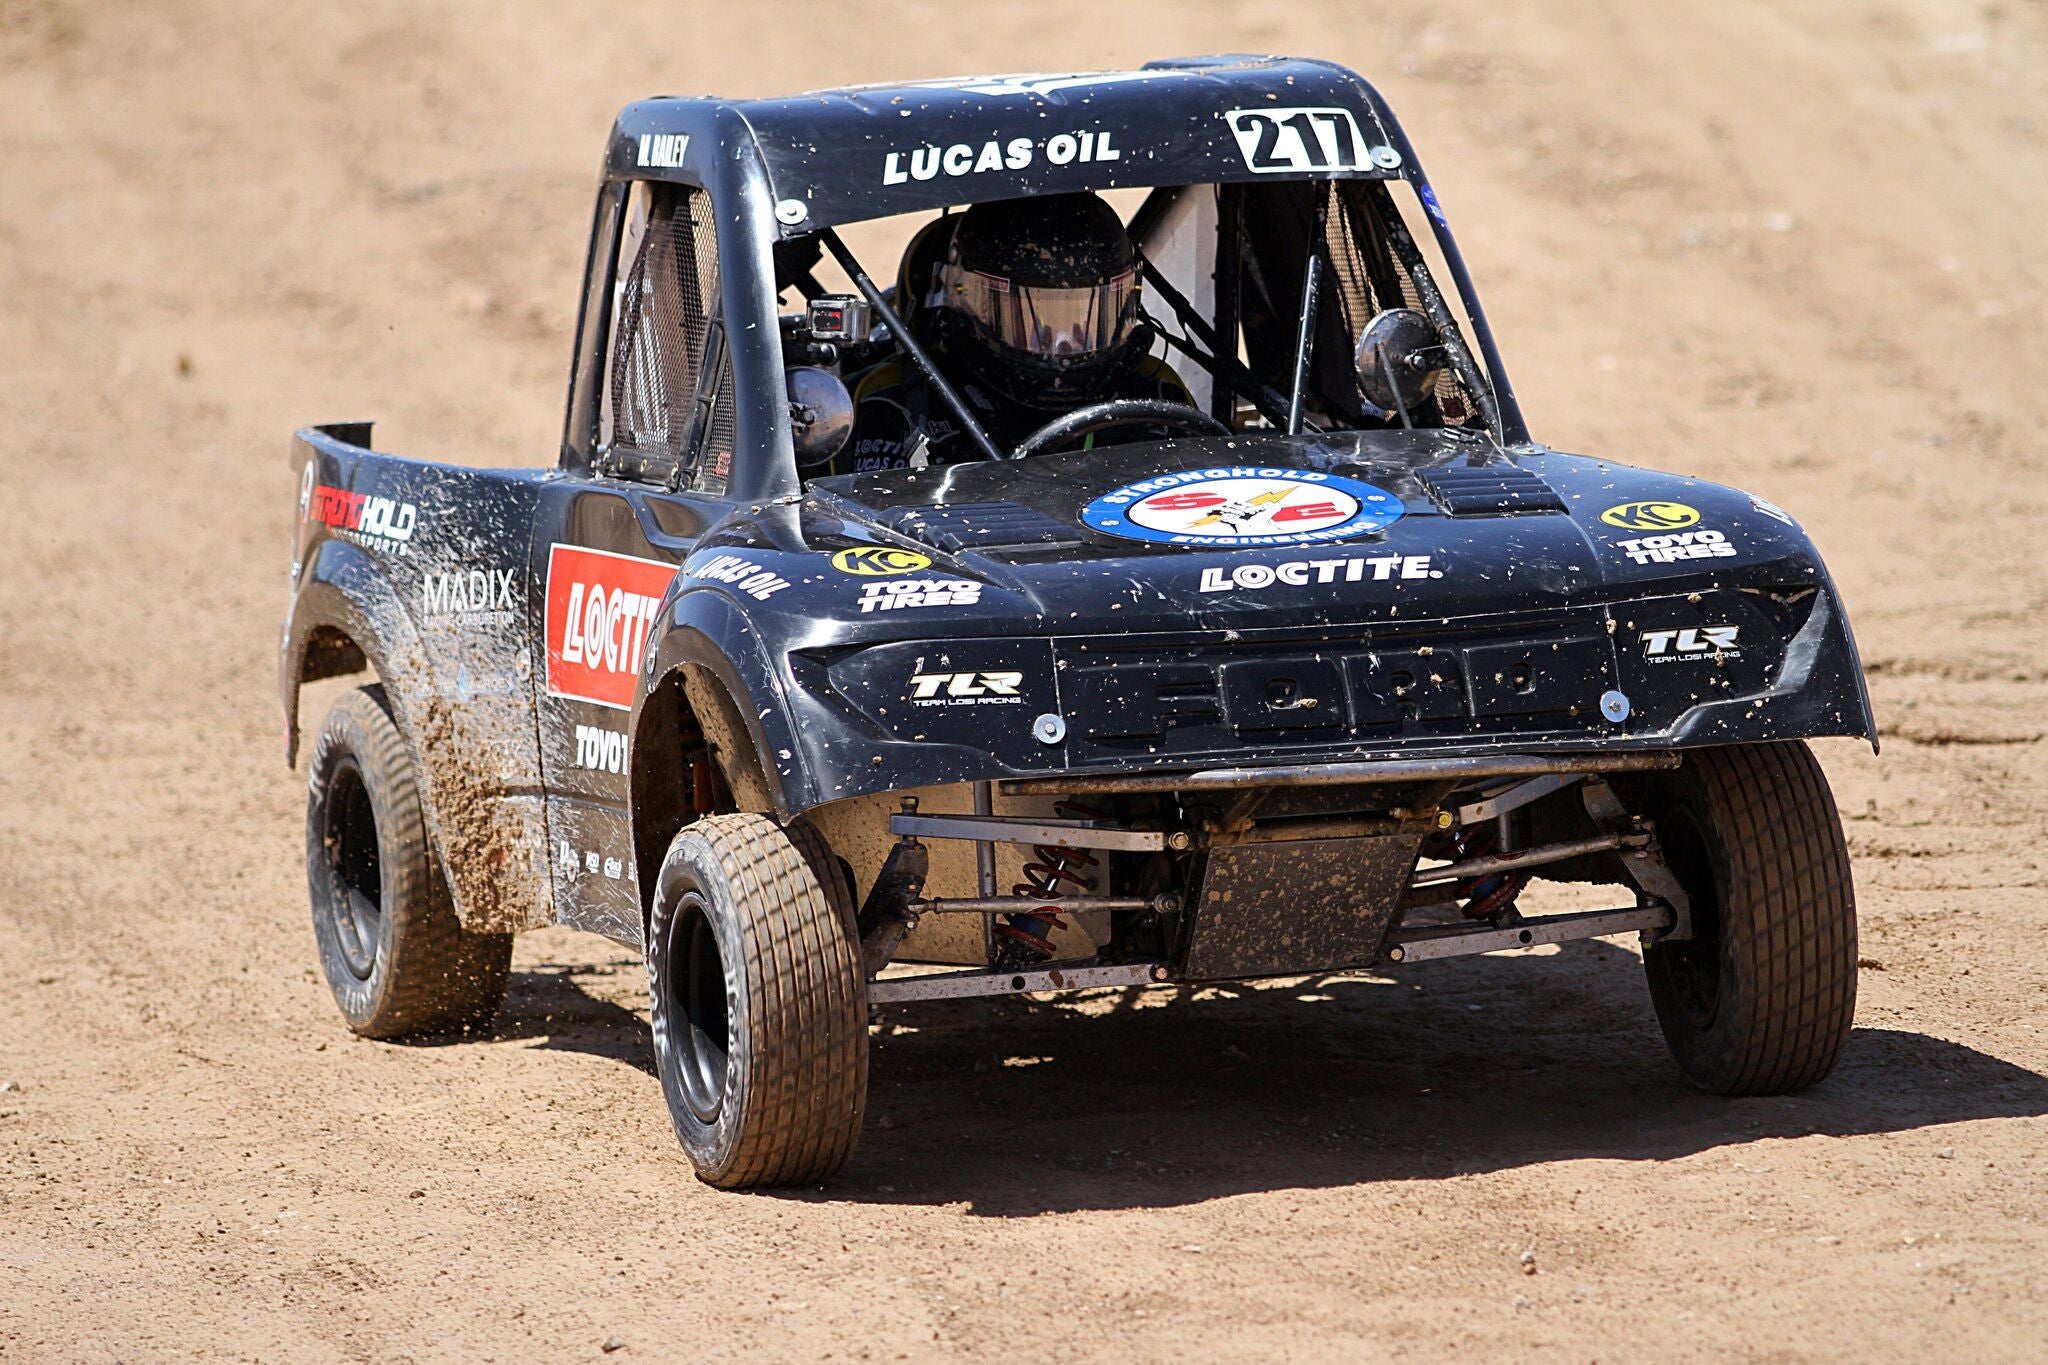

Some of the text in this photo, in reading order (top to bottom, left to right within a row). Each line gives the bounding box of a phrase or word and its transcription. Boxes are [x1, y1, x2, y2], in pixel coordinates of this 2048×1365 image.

[651, 134, 690, 168] BAILEY
[1236, 113, 1357, 168] 217
[883, 131, 1121, 186] LUCAS OIL
[856, 456, 891, 473] UCAS
[1102, 467, 1328, 505] STRONGHOLD
[310, 484, 416, 541] STRONGHOLD
[1609, 503, 1691, 527] KC
[1169, 521, 1379, 544] ENGINEERING
[1616, 530, 1726, 552] TOYO
[844, 550, 919, 572] KC
[1625, 542, 1737, 565] TIRES
[423, 568, 514, 613] MADIX
[692, 555, 791, 601] LUCAS OIL
[861, 580, 982, 597] TOYO
[857, 592, 981, 613] TIRES
[562, 582, 661, 676] LOCTIT
[1641, 626, 1739, 655] TLR
[1647, 651, 1741, 664] TEAM LOSI RAING
[909, 671, 1024, 699] TLR
[913, 697, 1021, 707] TEAM LOSI RACING
